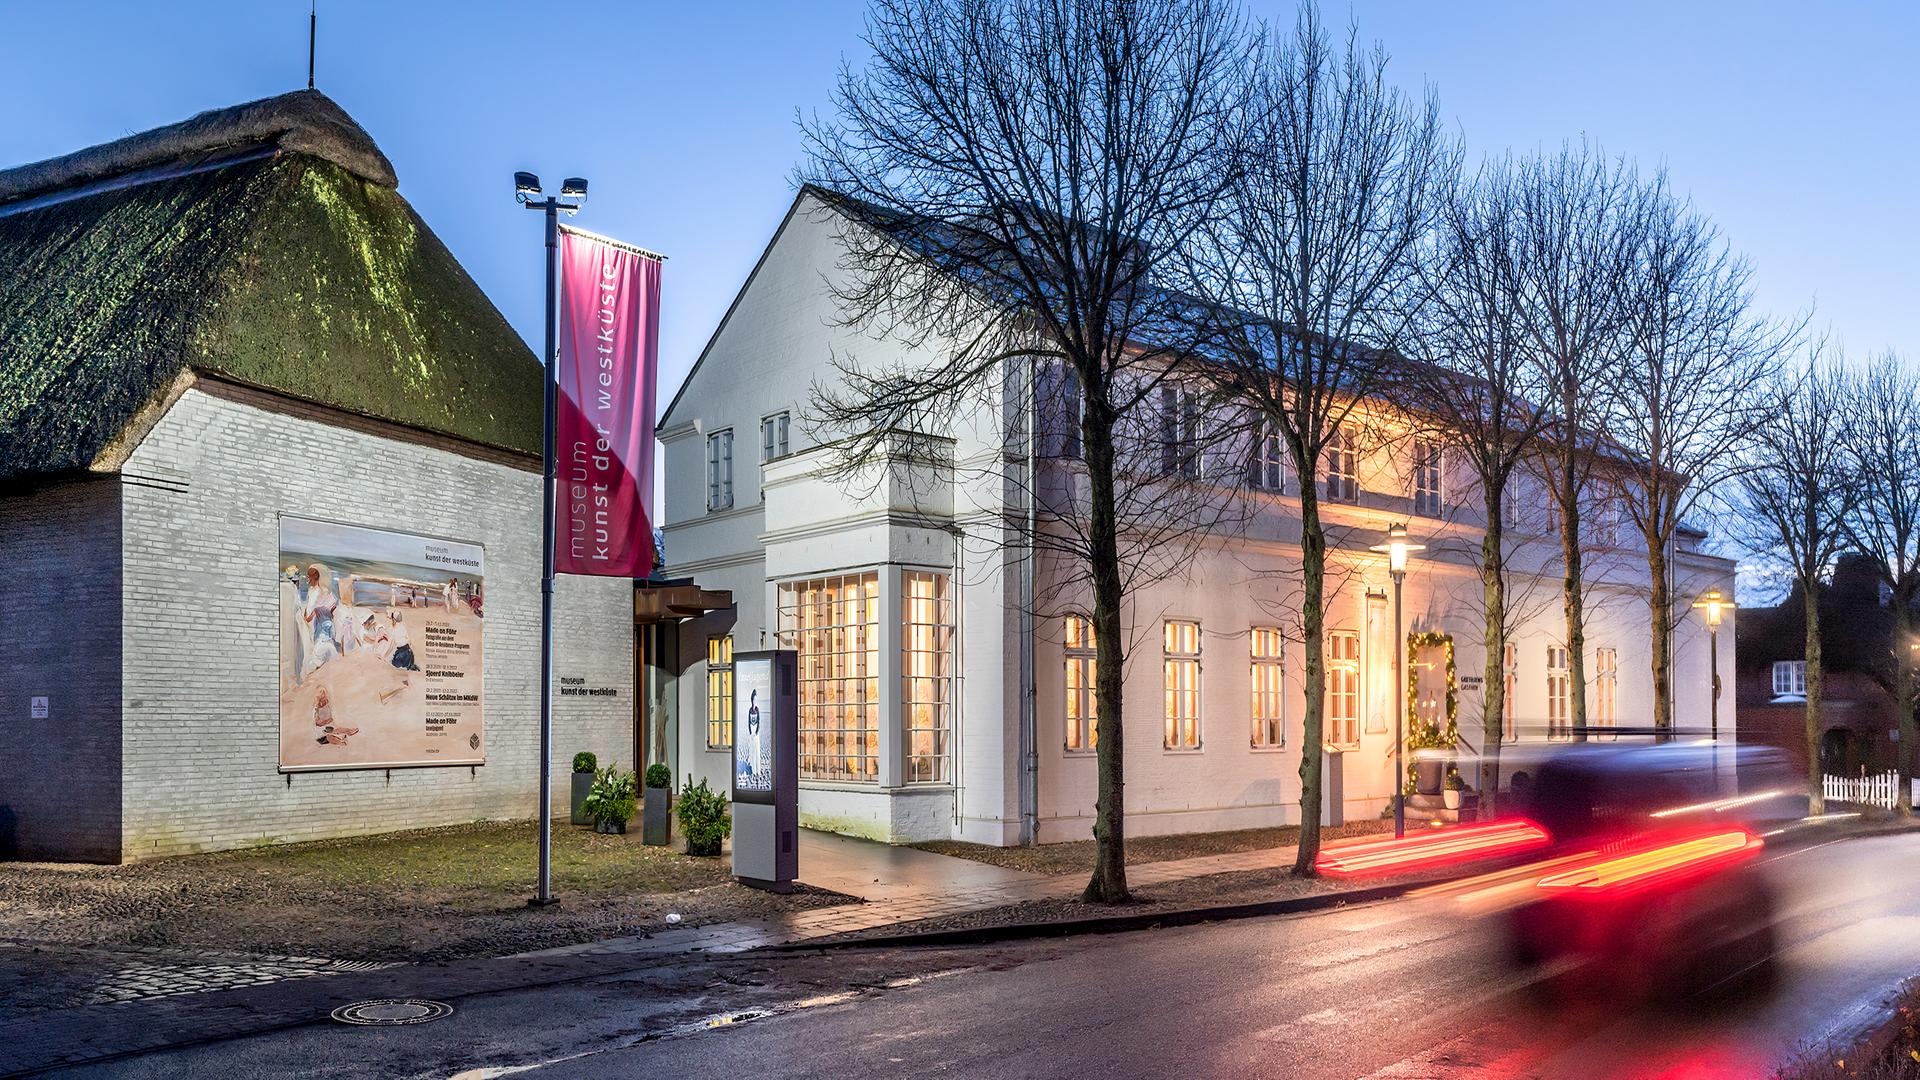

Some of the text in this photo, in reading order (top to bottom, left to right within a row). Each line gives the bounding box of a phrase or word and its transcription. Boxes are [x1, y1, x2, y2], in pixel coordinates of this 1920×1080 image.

[592, 262, 617, 561] kunst der westküste
[571, 441, 587, 559] museum
[426, 546, 449, 554] museum
[426, 554, 441, 562] kunst
[454, 559, 480, 567] westküste
[561, 687, 617, 697] kunst der westküste
